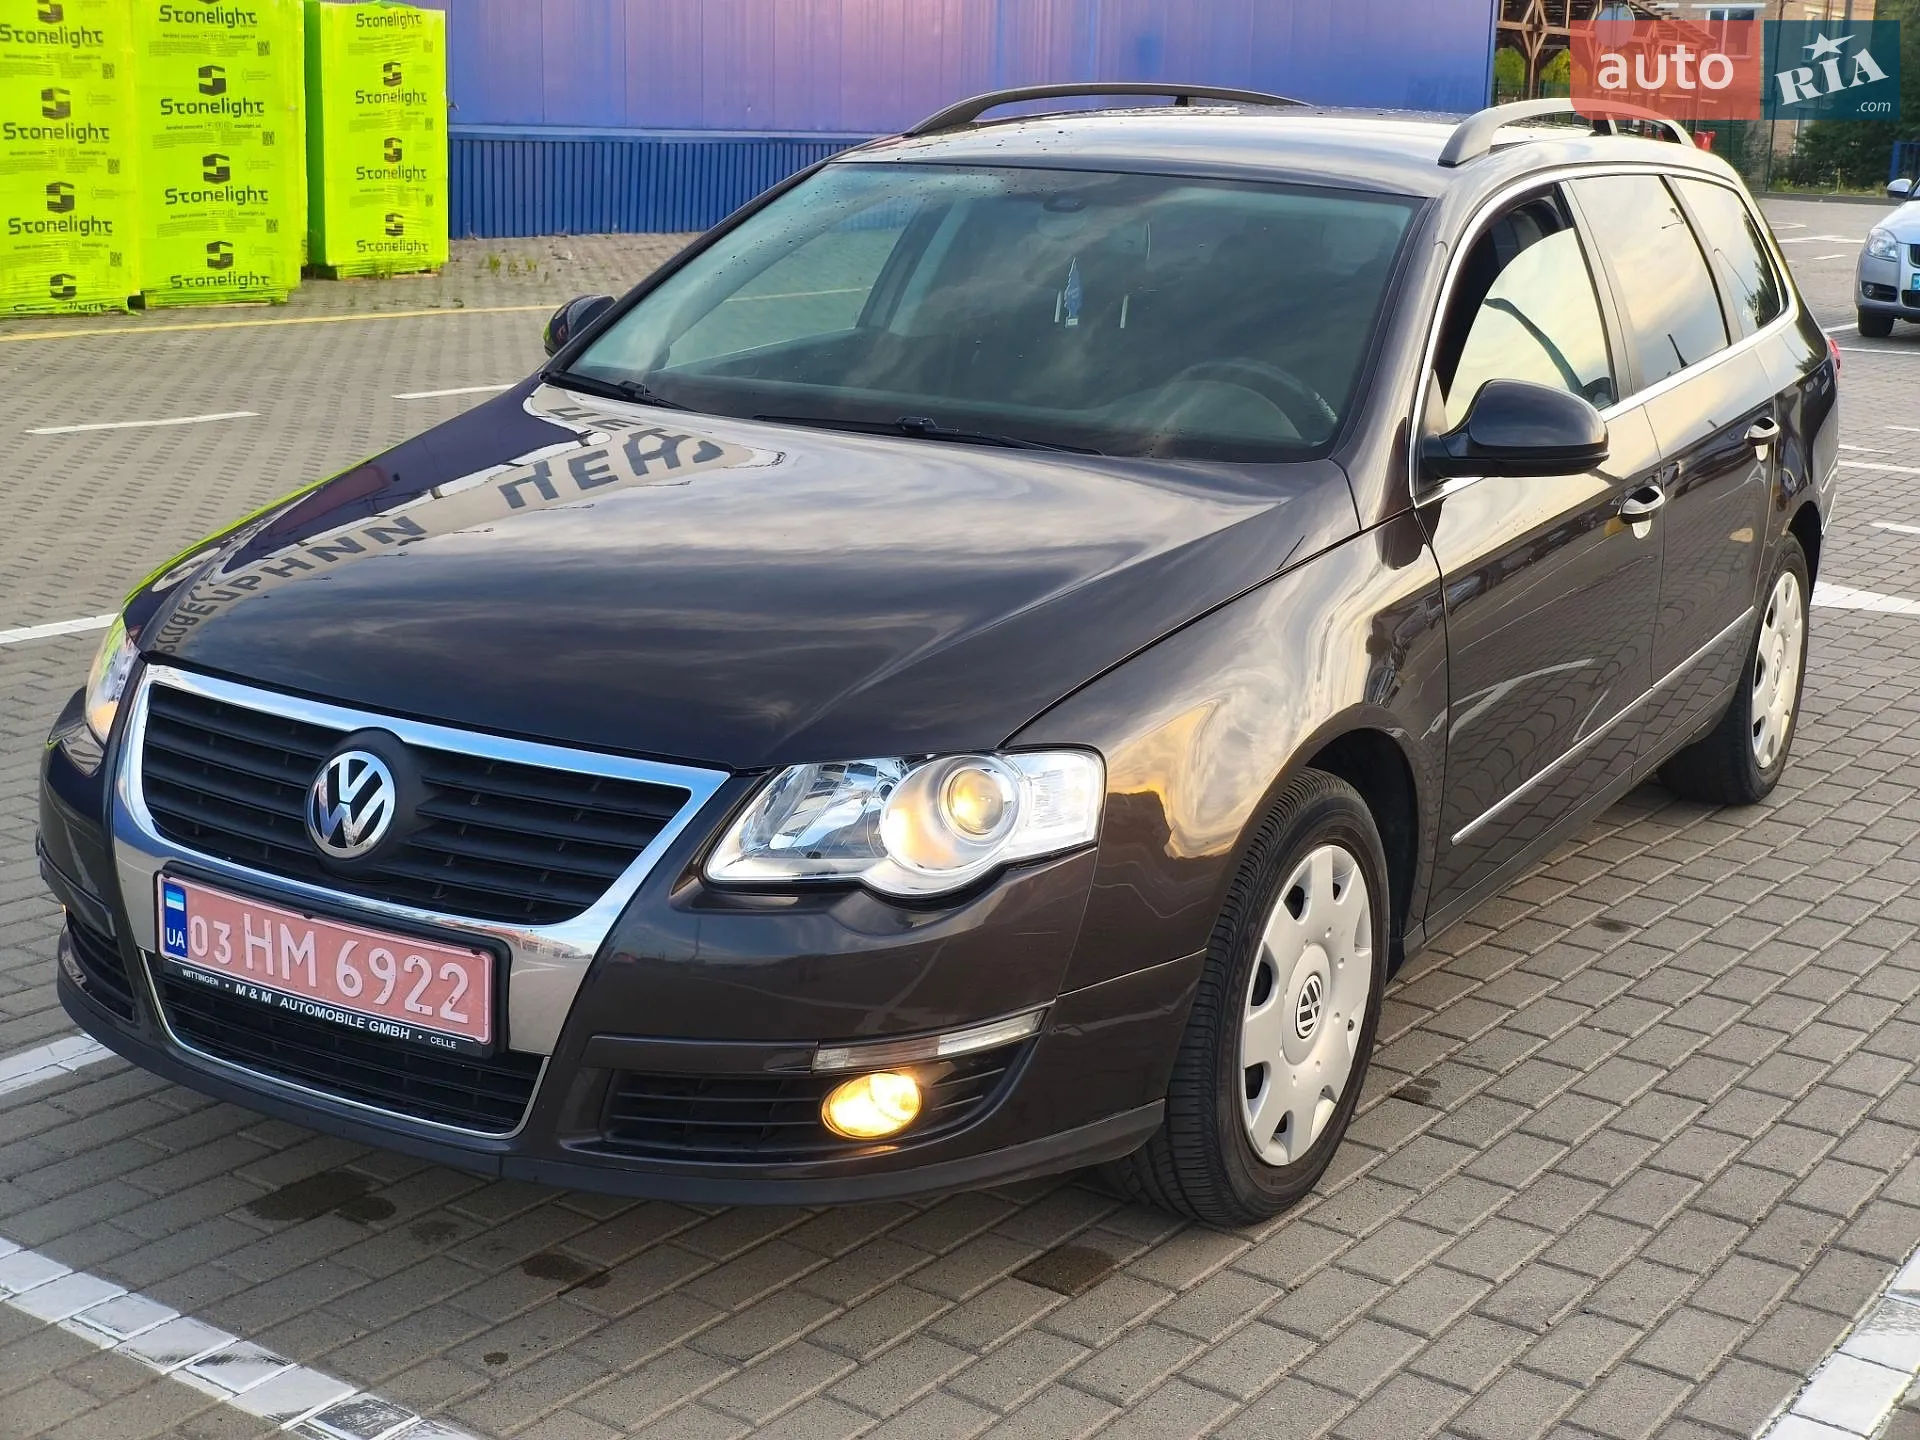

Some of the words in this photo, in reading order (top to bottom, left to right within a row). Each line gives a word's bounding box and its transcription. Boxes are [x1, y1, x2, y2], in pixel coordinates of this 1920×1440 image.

[160, 5, 258, 28] Stonelight
[356, 11, 422, 29] Stonelight
[0, 24, 104, 48] Stonelight
[355, 88, 427, 106] Stonelight
[160, 98, 264, 118] Stonelight
[3, 122, 110, 144] Stonelight
[356, 165, 427, 182] Stonelight
[165, 186, 269, 206] Stonelight
[8, 216, 113, 236] Stonelight
[356, 239, 429, 255] Stonelight
[170, 272, 270, 289] Stonelight
[167, 927, 185, 949] UA
[189, 915, 232, 964] 03
[243, 913, 317, 988] HM
[336, 940, 469, 1024] 6922
[181, 969, 219, 986] WITTINGEN
[236, 984, 246, 996] M
[249, 988, 258, 999] &
[261, 991, 272, 1003] M
[279, 997, 365, 1029] AUTOMOBILE
[368, 1020, 411, 1040] GMBH
[430, 1036, 457, 1049] CELLE
